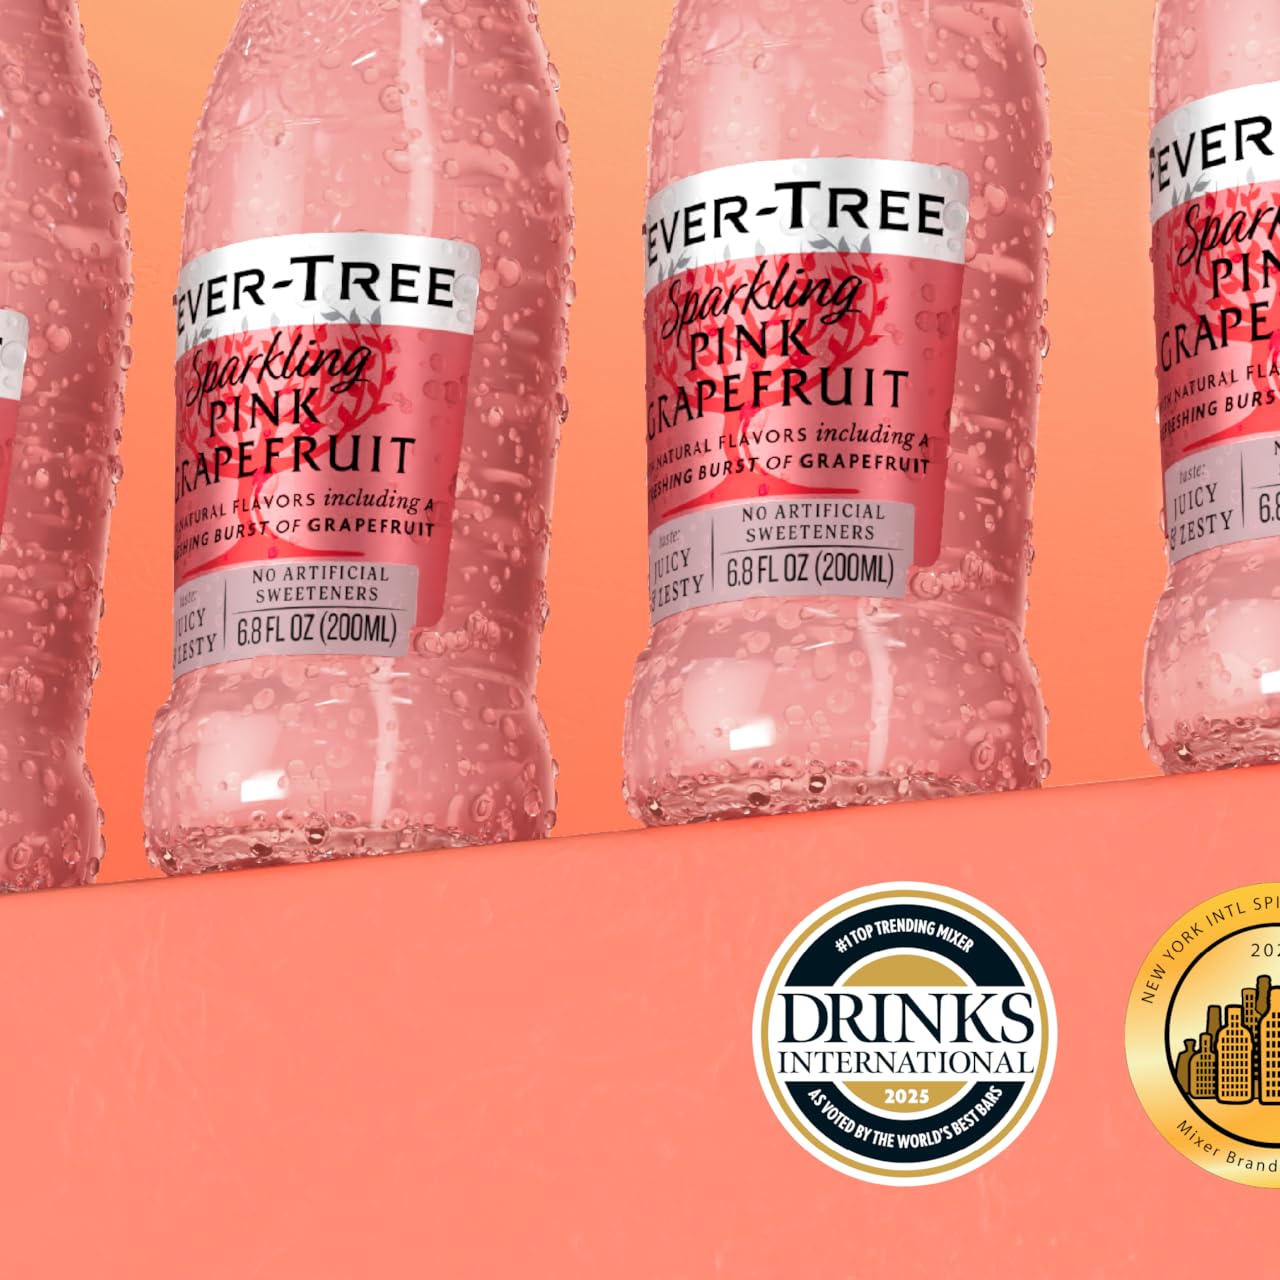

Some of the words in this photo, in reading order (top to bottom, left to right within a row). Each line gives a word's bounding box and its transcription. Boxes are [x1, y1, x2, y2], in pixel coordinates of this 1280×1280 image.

[643, 181, 944, 265] EVER-TREE
[173, 255, 455, 336] EVER-TREE
[661, 260, 862, 348] Sparkling
[690, 320, 810, 370] PINK
[186, 331, 372, 417] Sparkling
[1176, 369, 1238, 400] NATURAL
[209, 388, 321, 437] PINK
[719, 428, 807, 448] FLAVORS
[816, 422, 915, 451] including
[698, 458, 760, 480] BURST
[801, 454, 929, 474] GRAPEFRUIT
[324, 488, 421, 514] including
[775, 504, 885, 519] ARTIFICIAL
[1173, 483, 1218, 520] JUICY
[214, 521, 270, 542] BURST
[308, 519, 435, 536] GRAPEFRUIT
[746, 526, 874, 542] SWEETENERS
[1180, 510, 1234, 545] ZESTY
[284, 566, 389, 581] ARTIFICIAL
[727, 557, 752, 586] 6.8
[758, 556, 778, 582] FL
[784, 554, 809, 581] OZ
[815, 551, 894, 588] (200ML)
[256, 587, 378, 603] SWEETENERS
[237, 617, 261, 646] 6.8
[266, 616, 284, 642] FL
[291, 614, 315, 641] OZ
[320, 611, 397, 647] (200ML)
